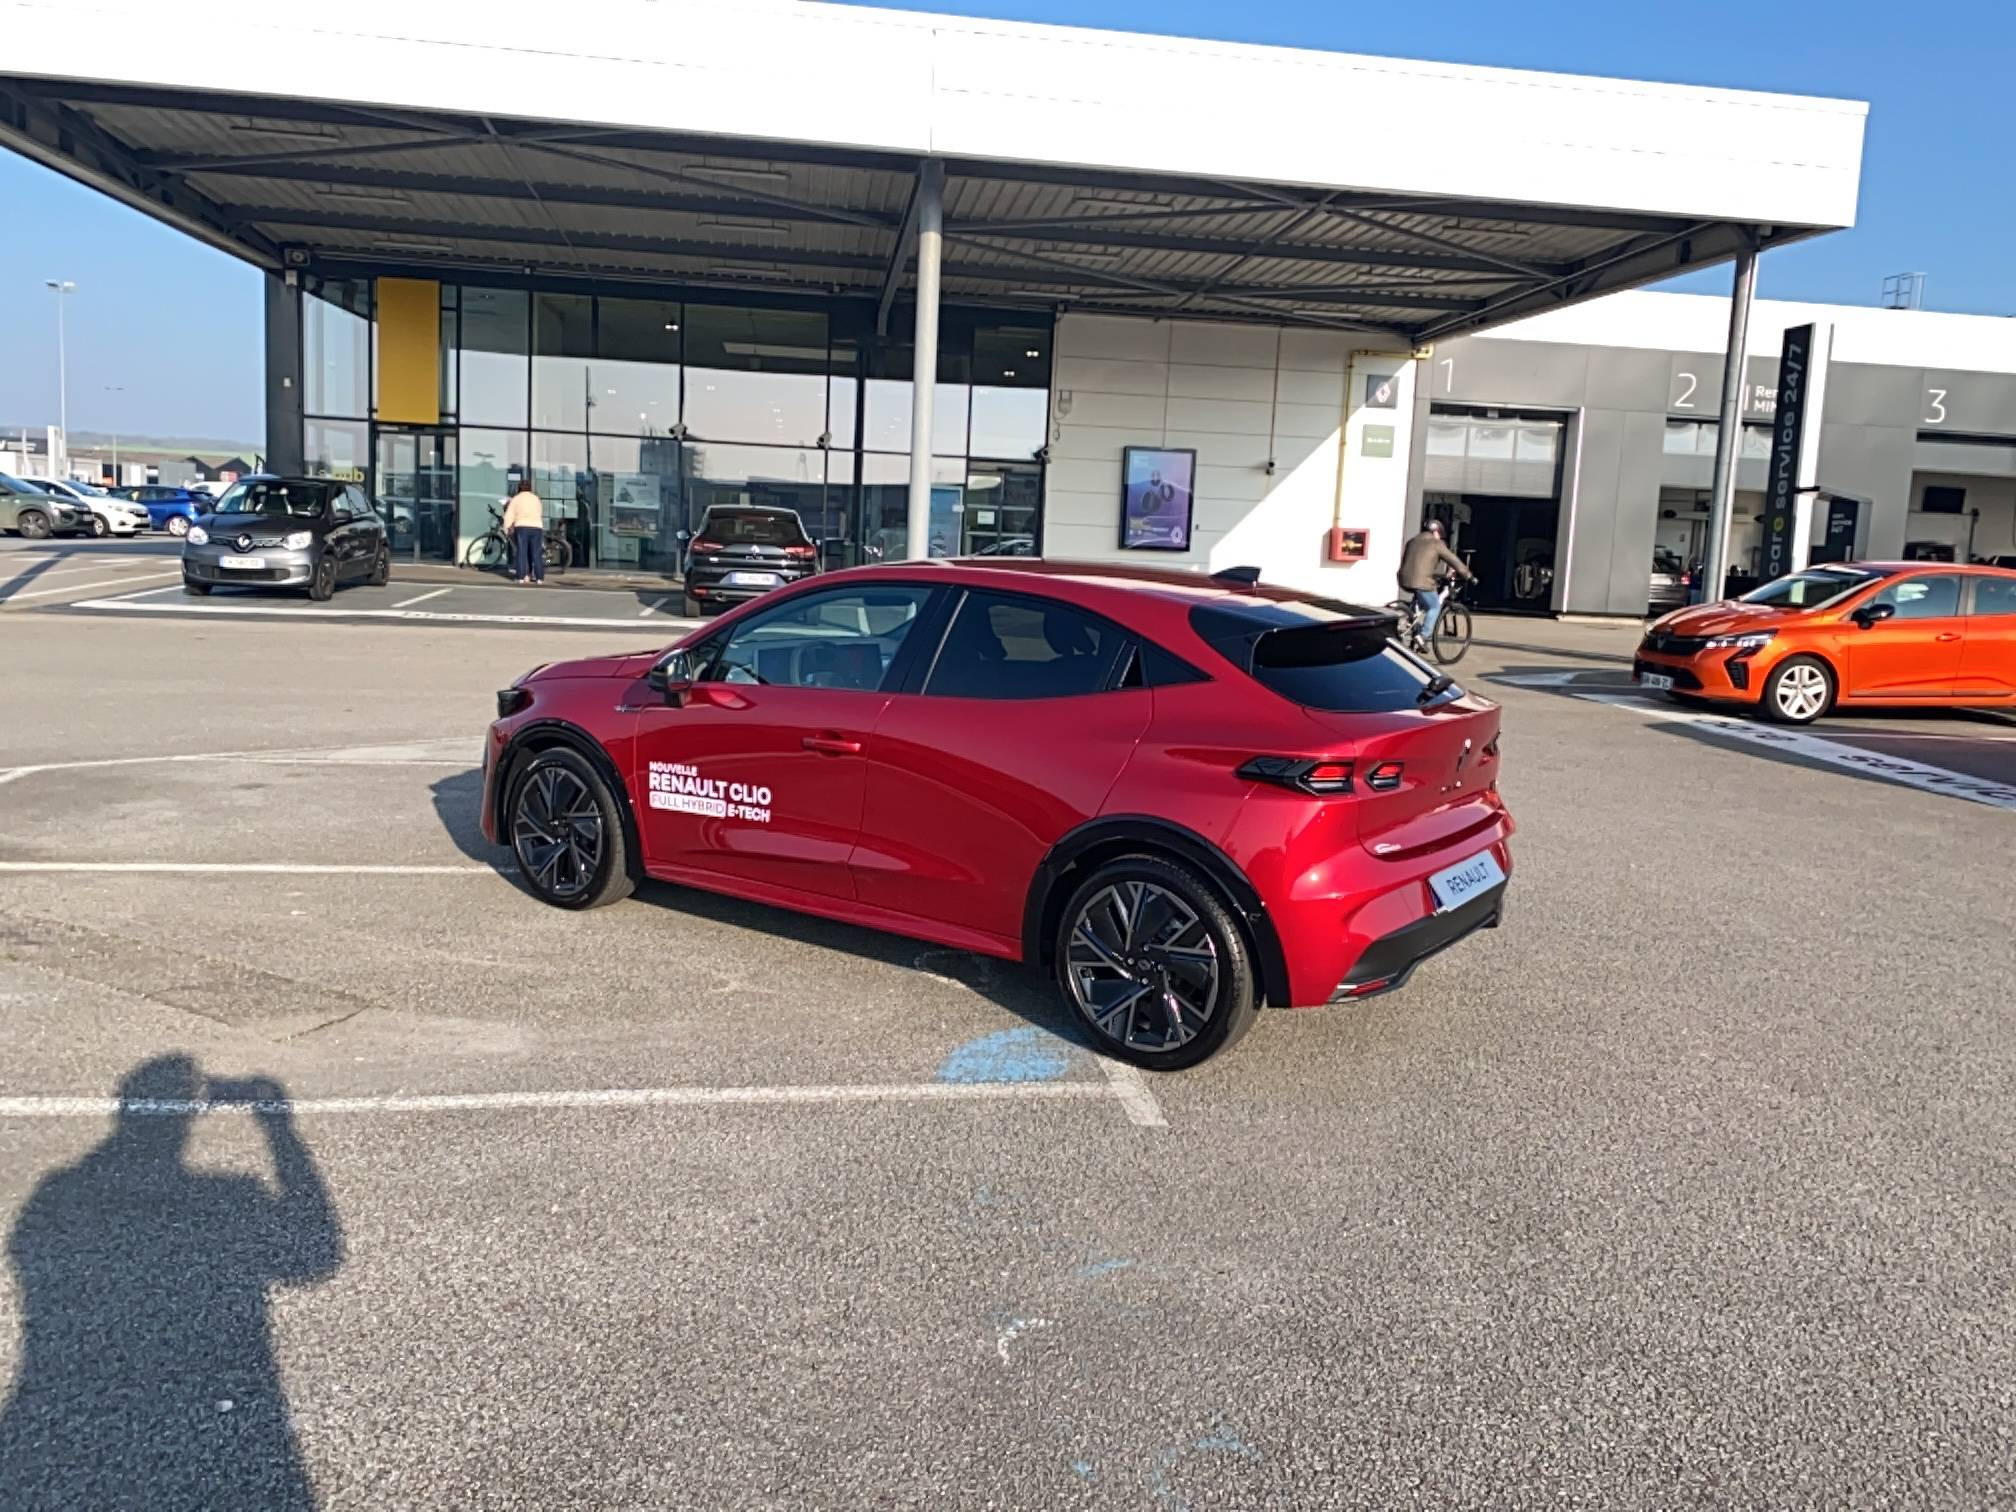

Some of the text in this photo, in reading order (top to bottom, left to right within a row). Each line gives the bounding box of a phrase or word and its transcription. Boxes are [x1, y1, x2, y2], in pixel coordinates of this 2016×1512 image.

[1440, 357, 1453, 392] 1
[1674, 373, 1697, 408] 2
[1925, 389, 1947, 423] 3
[1769, 344, 1803, 577] care service 24/7
[649, 761, 698, 777] NOUVELLE
[649, 772, 771, 805] RENAULT CLIO
[652, 794, 680, 808] FULL
[682, 797, 725, 815] HYBRID
[1446, 862, 1488, 895] RENAULT
